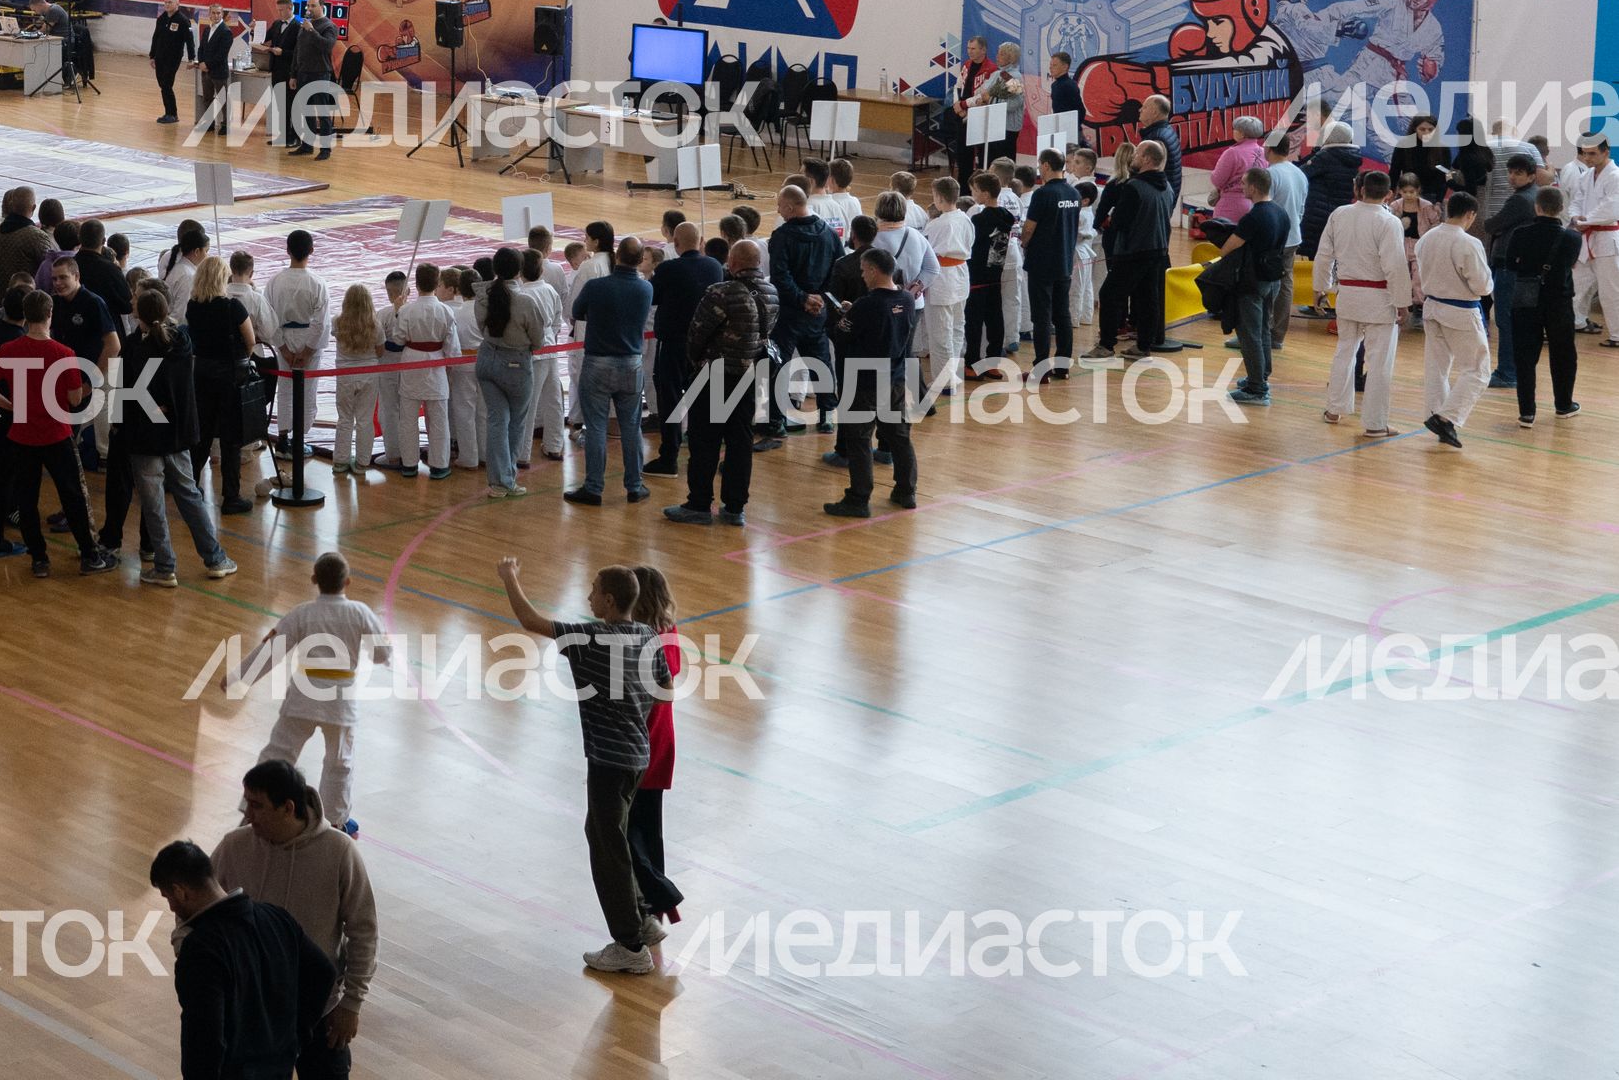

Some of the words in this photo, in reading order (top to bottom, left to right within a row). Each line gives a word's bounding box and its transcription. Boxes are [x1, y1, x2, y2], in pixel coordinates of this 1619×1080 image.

[337, 7, 343, 18] 0
[1172, 58, 1291, 114] БУДУЩИЙ
[604, 120, 611, 134] 3
[1057, 200, 1079, 208] СУДЬЯ
